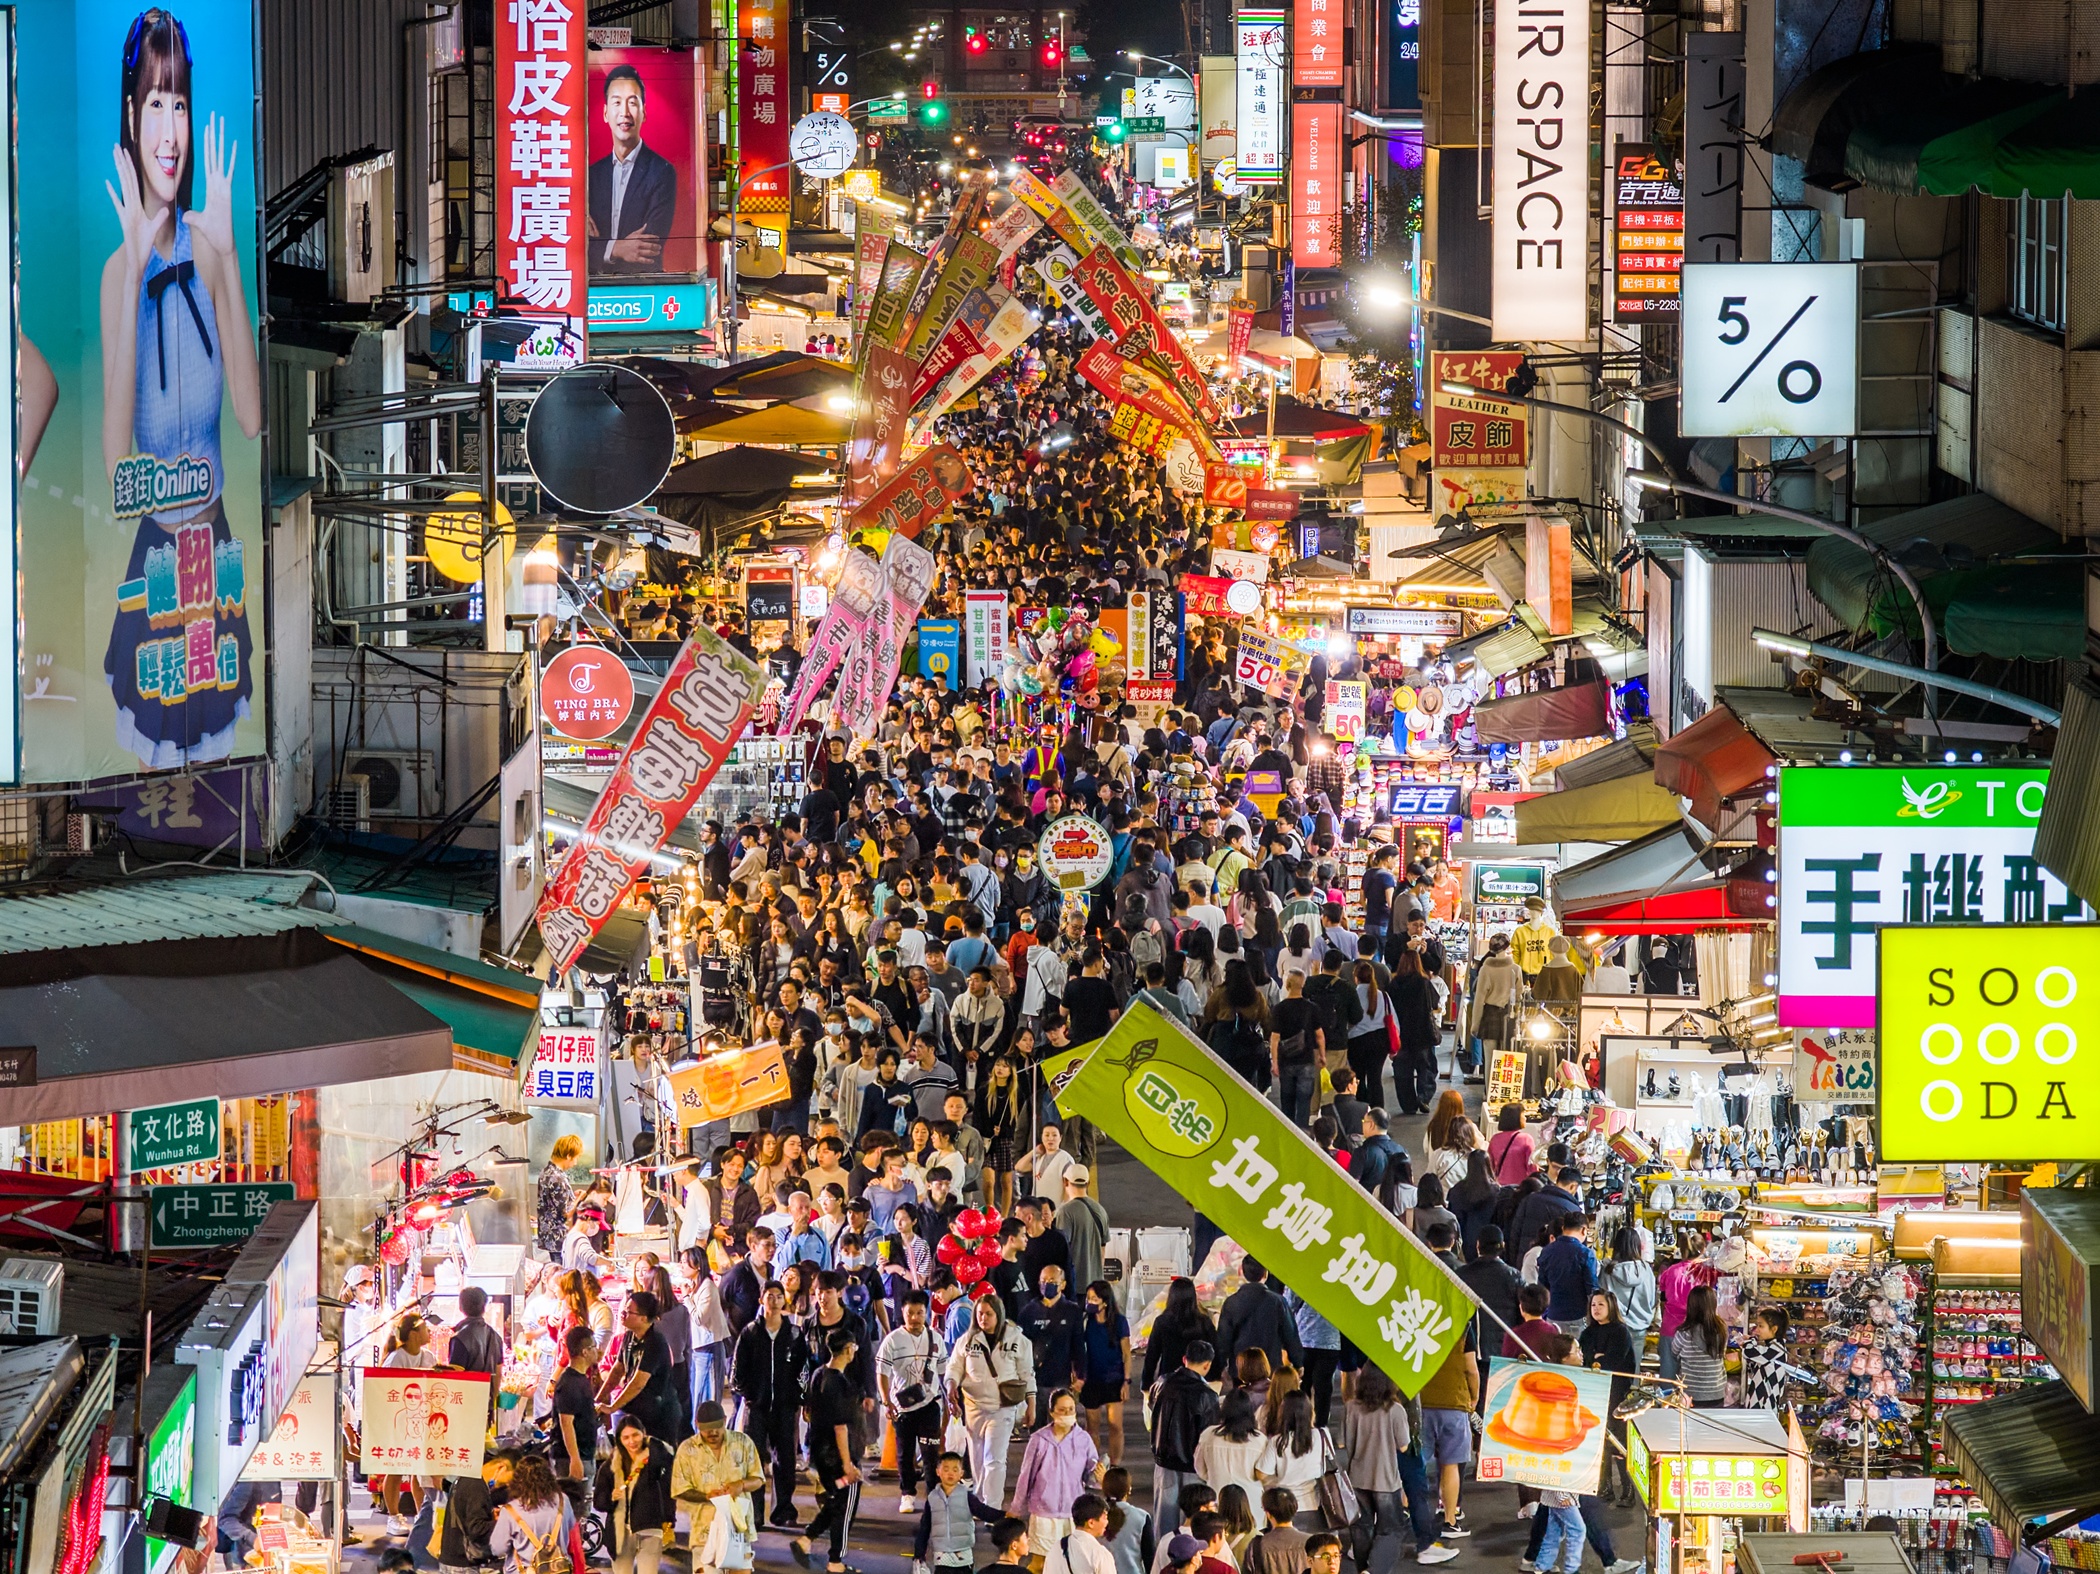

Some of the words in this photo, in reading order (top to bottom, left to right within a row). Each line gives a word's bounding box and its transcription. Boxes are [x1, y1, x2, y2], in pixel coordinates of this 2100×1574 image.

[1515, 0, 1564, 59] IR
[1309, 116, 1320, 171] WELCOME
[1515, 79, 1564, 271] SPACE
[1306, 179, 1321, 254] 歡迎來嘉
[587, 300, 642, 318] atsons
[1449, 396, 1510, 416] LEATHER
[1448, 420, 1514, 450] 皮飾
[1438, 452, 1521, 466] 歡迎團體訂購
[117, 525, 246, 615] 一鍵翻轉
[972, 607, 986, 662] 甘草芭樂
[990, 608, 1003, 662] 蜜餞番茄
[136, 619, 241, 698] 輕鬆萬倍
[1237, 656, 1274, 686] 50
[554, 699, 587, 709] TING
[593, 699, 621, 709] BRA
[537, 1033, 596, 1066] 蚵仔煎
[1838, 1049, 1876, 1060] 特約商
[535, 1068, 596, 1100] 臭豆腐
[1133, 1068, 1214, 1146] 日常
[142, 1108, 206, 1146] 文化路
[145, 1146, 185, 1163] Wunhua
[186, 1143, 203, 1158] Rd.
[172, 1189, 272, 1221] 中正路
[1209, 1133, 1454, 1373] 甘草芭樂
[297, 1390, 312, 1404] 派
[387, 1389, 401, 1403] 金
[450, 1390, 464, 1405] 派
[272, 1452, 285, 1466] &
[289, 1451, 323, 1467] 泡芙
[371, 1446, 421, 1461] 牛奶棒
[426, 1447, 436, 1461] &
[439, 1447, 472, 1463] 泡芙
